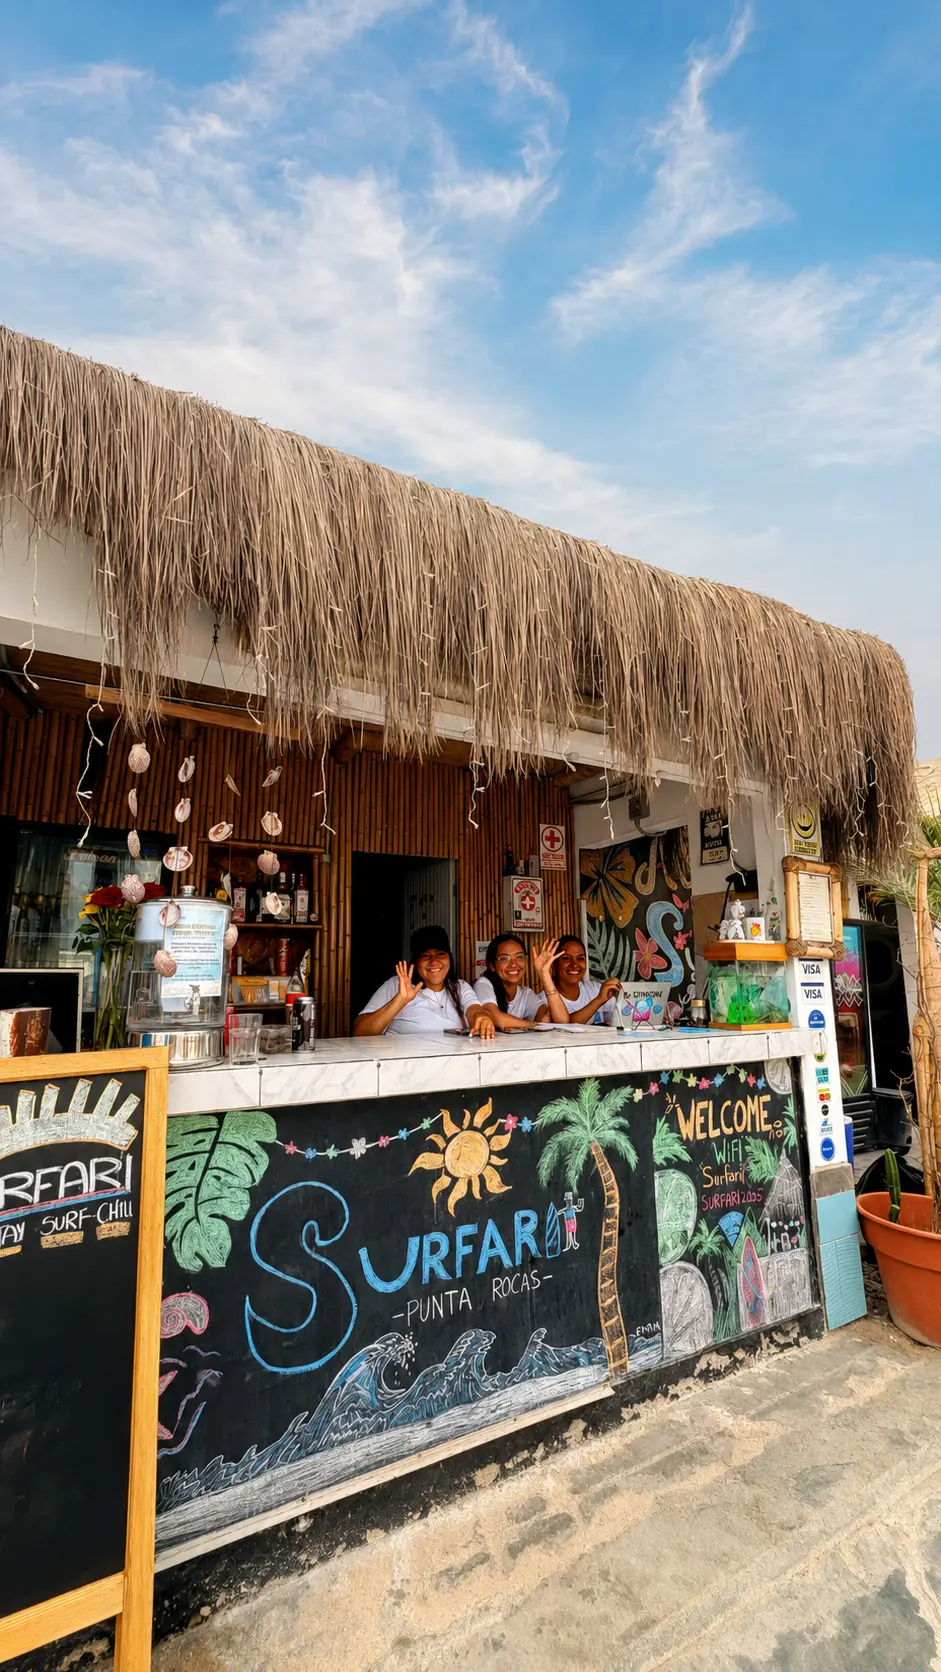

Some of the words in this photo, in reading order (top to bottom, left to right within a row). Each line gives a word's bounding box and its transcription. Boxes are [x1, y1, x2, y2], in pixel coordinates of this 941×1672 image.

[802, 964, 821, 975] VISA
[804, 989, 822, 999] VISA
[676, 1095, 772, 1141] WELCOME
